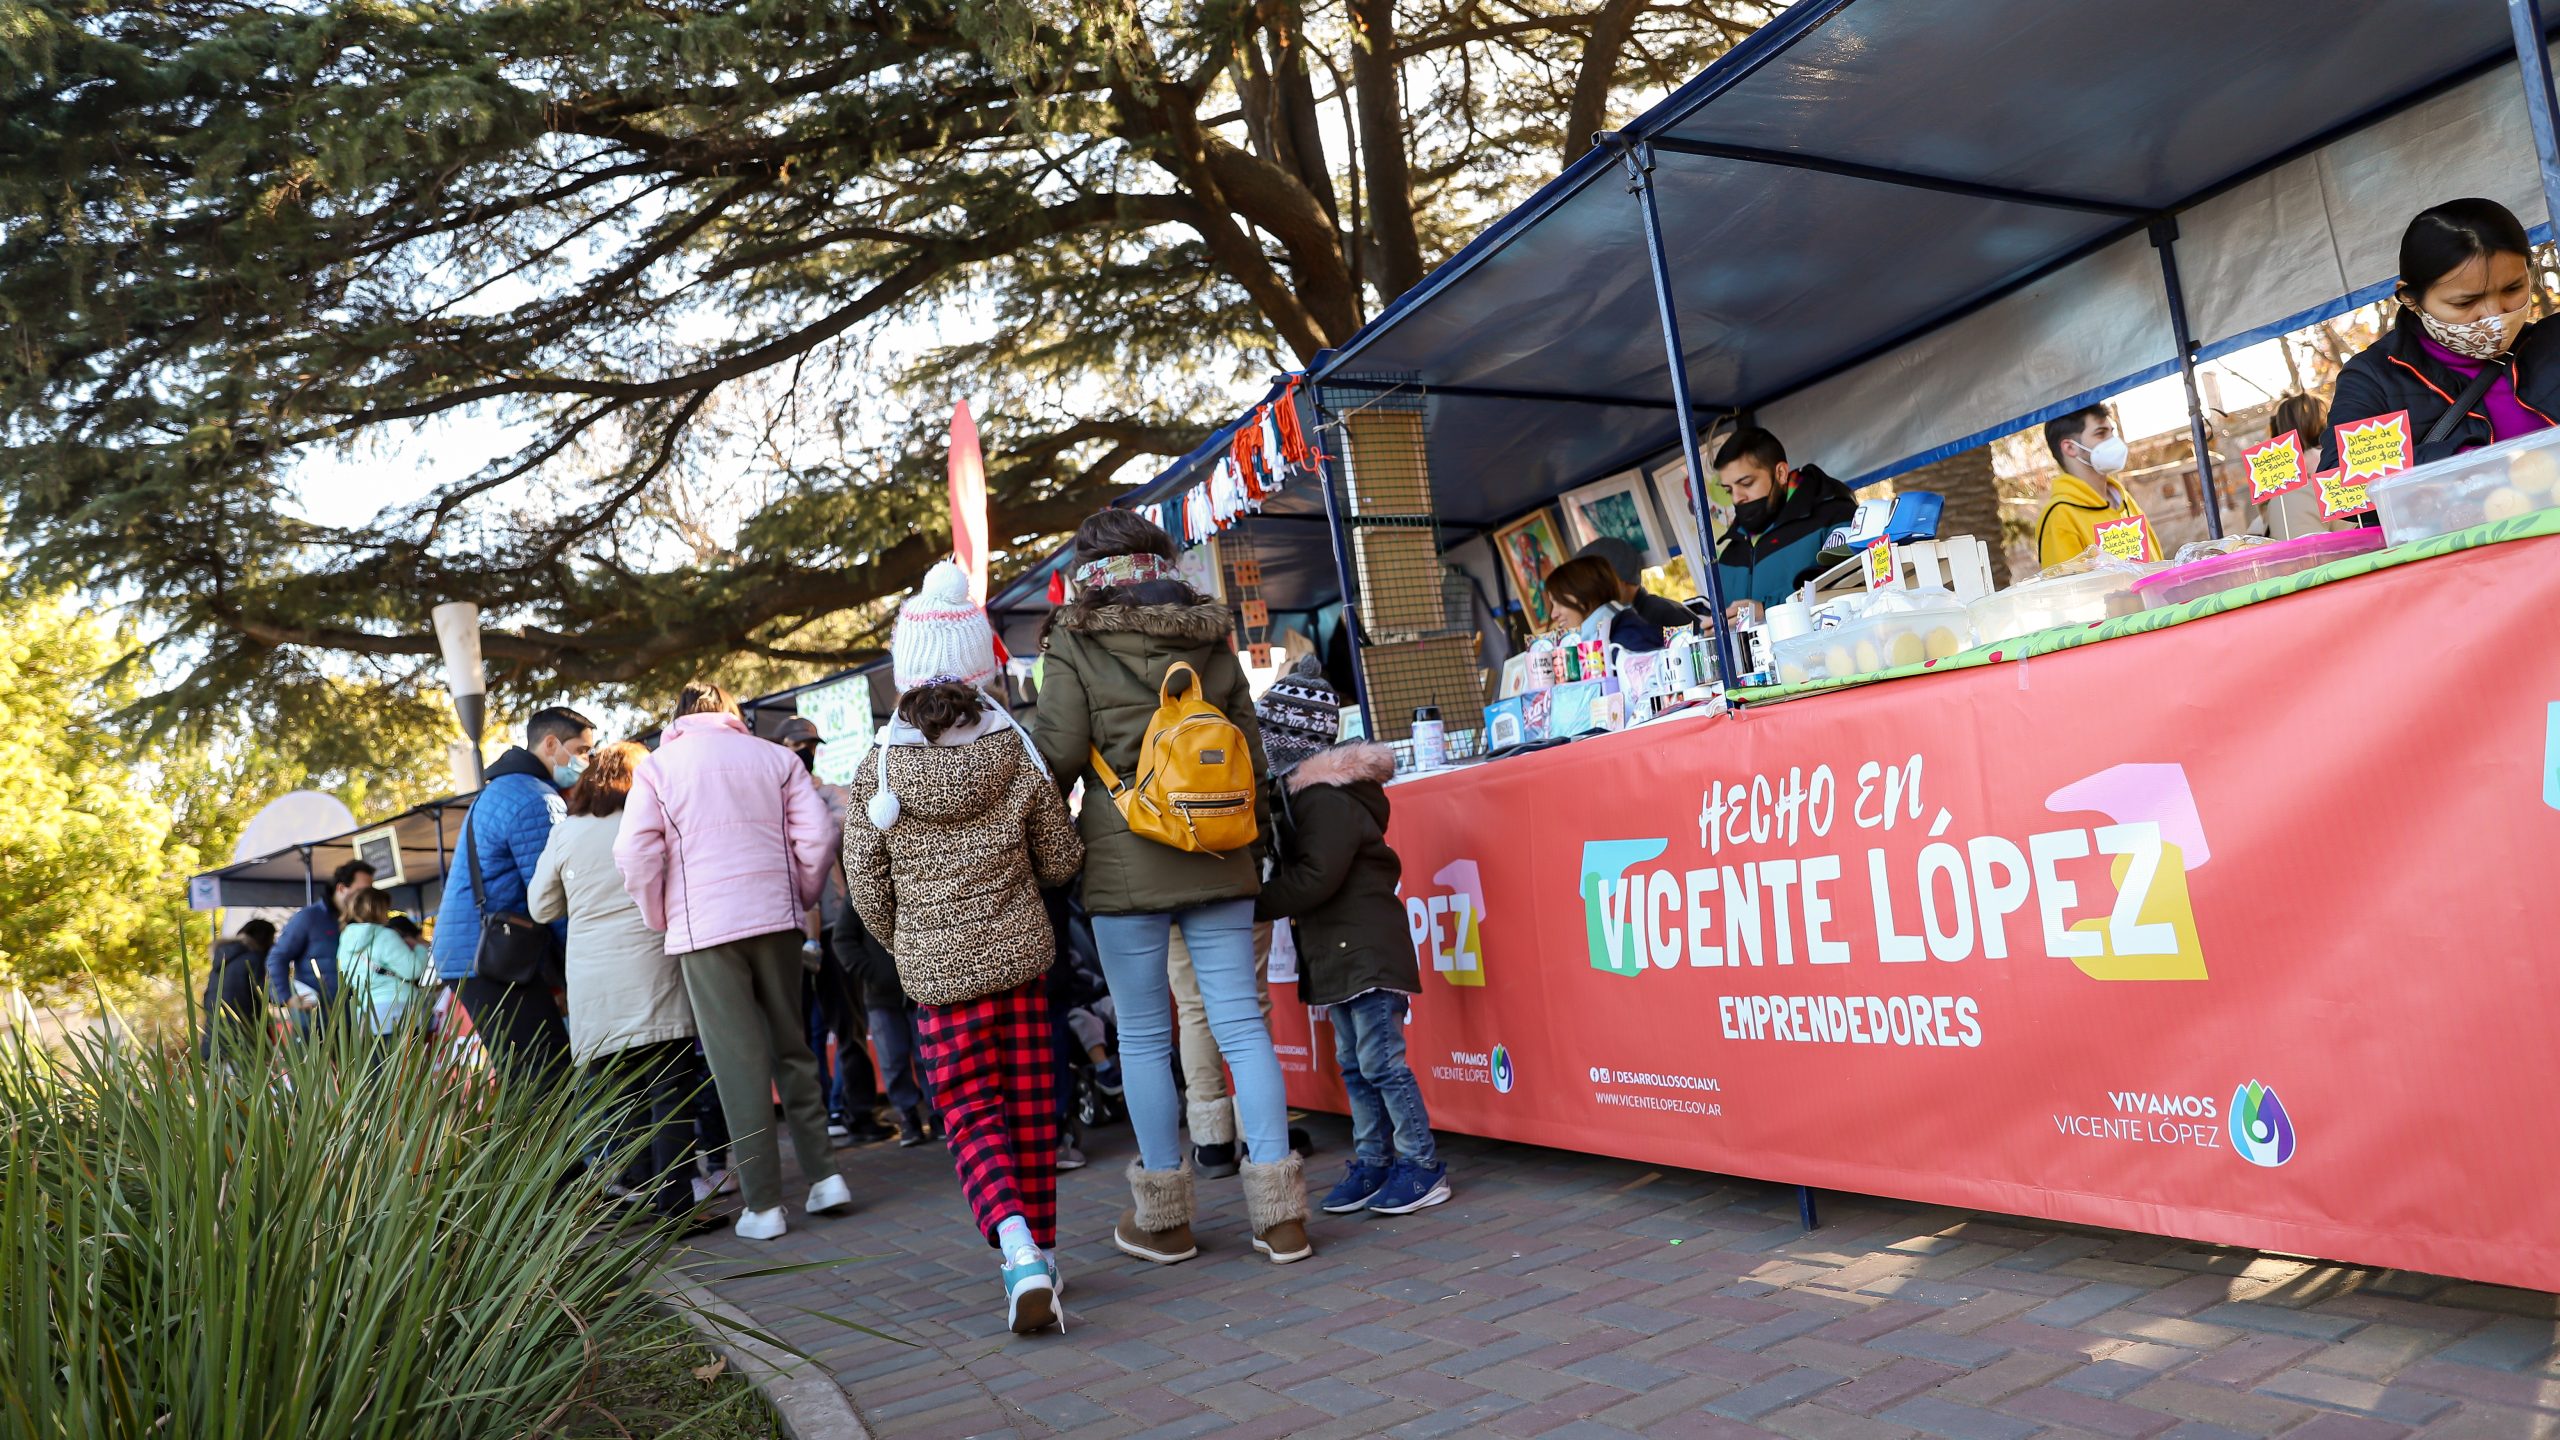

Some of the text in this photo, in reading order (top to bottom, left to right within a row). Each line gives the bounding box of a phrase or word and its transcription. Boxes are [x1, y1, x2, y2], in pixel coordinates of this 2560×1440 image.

[2380, 429, 2392, 438] de
[1699, 764, 1835, 856] HECHO
[1598, 807, 2179, 970] VICENTE LÓPEZ
[1404, 892, 1478, 972] PEZ
[1718, 995, 1983, 1048] EMPRENDEDORES
[1431, 1065, 1490, 1085] VICENTE LÓPEZ
[1451, 1051, 1489, 1067] VIVAMOS
[2107, 1091, 2218, 1118] VIVAMOS
[2053, 1114, 2220, 1148] VICENTE LÓPEZ
